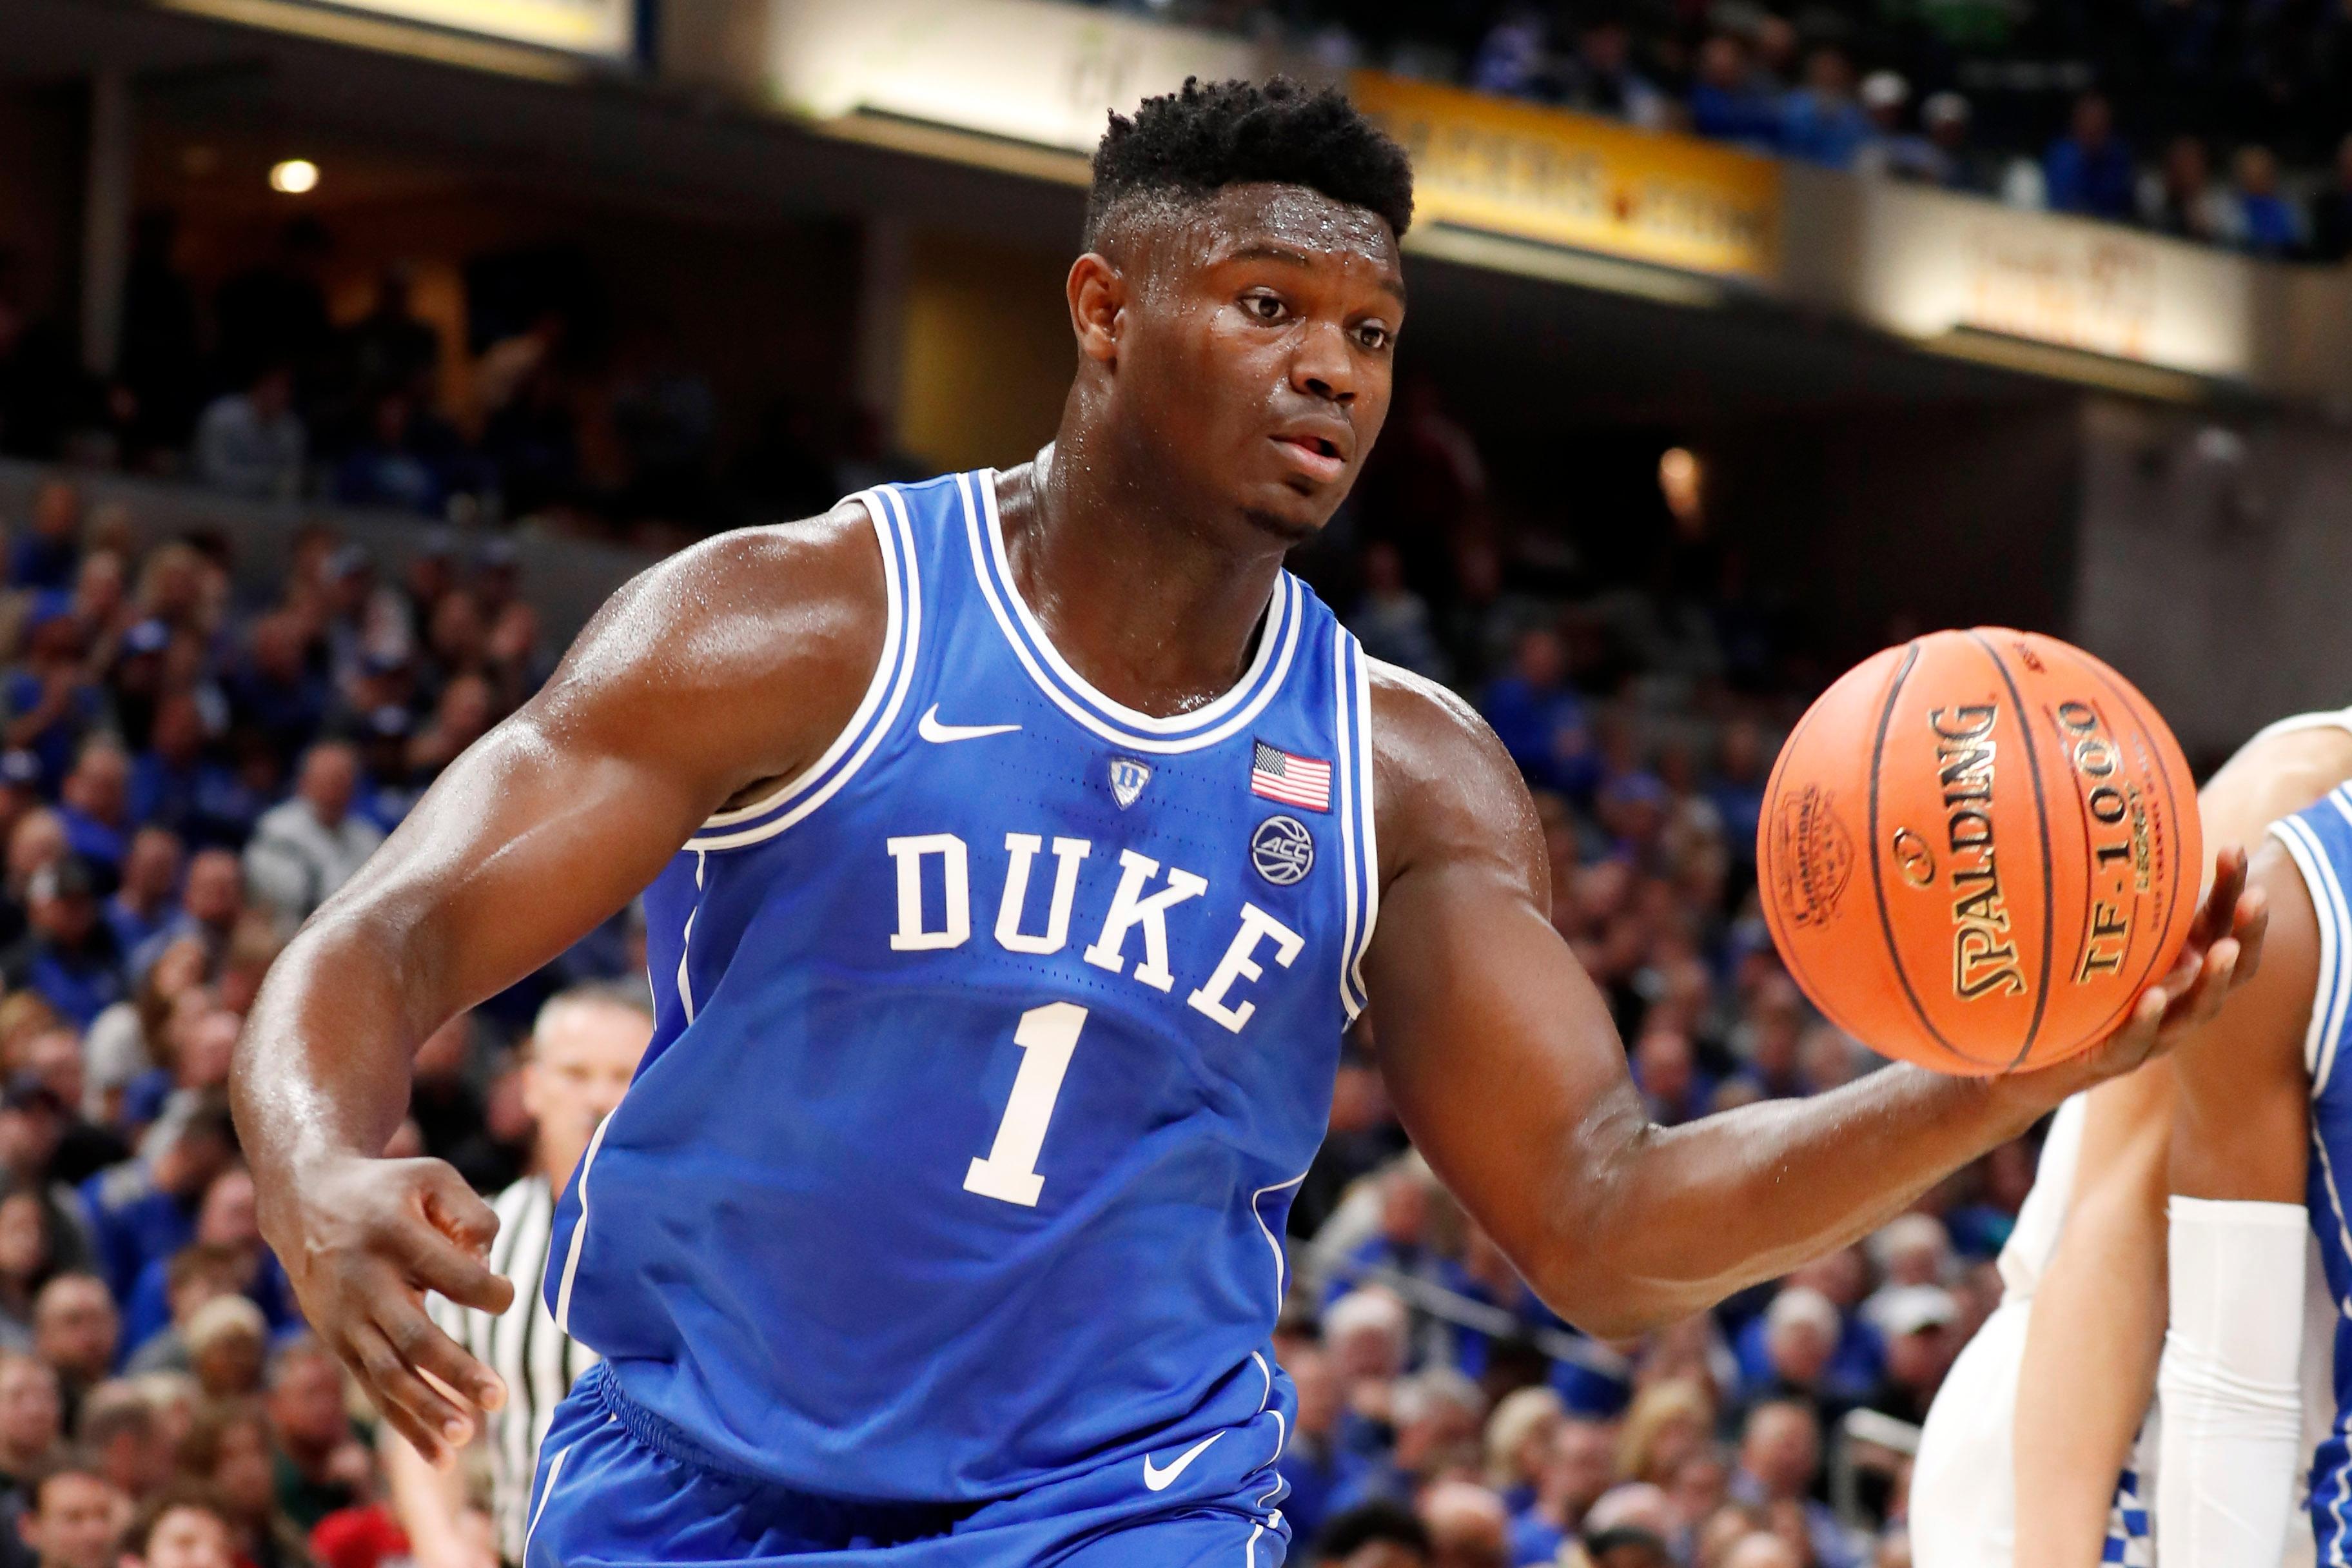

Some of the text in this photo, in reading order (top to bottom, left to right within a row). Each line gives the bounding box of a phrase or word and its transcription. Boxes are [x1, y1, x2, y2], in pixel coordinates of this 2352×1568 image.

[887, 832, 1306, 1034] DUKE
[1260, 836, 1311, 859] ACC
[1928, 702, 2027, 1002] SPALDING
[963, 1001, 1088, 1207] 1
